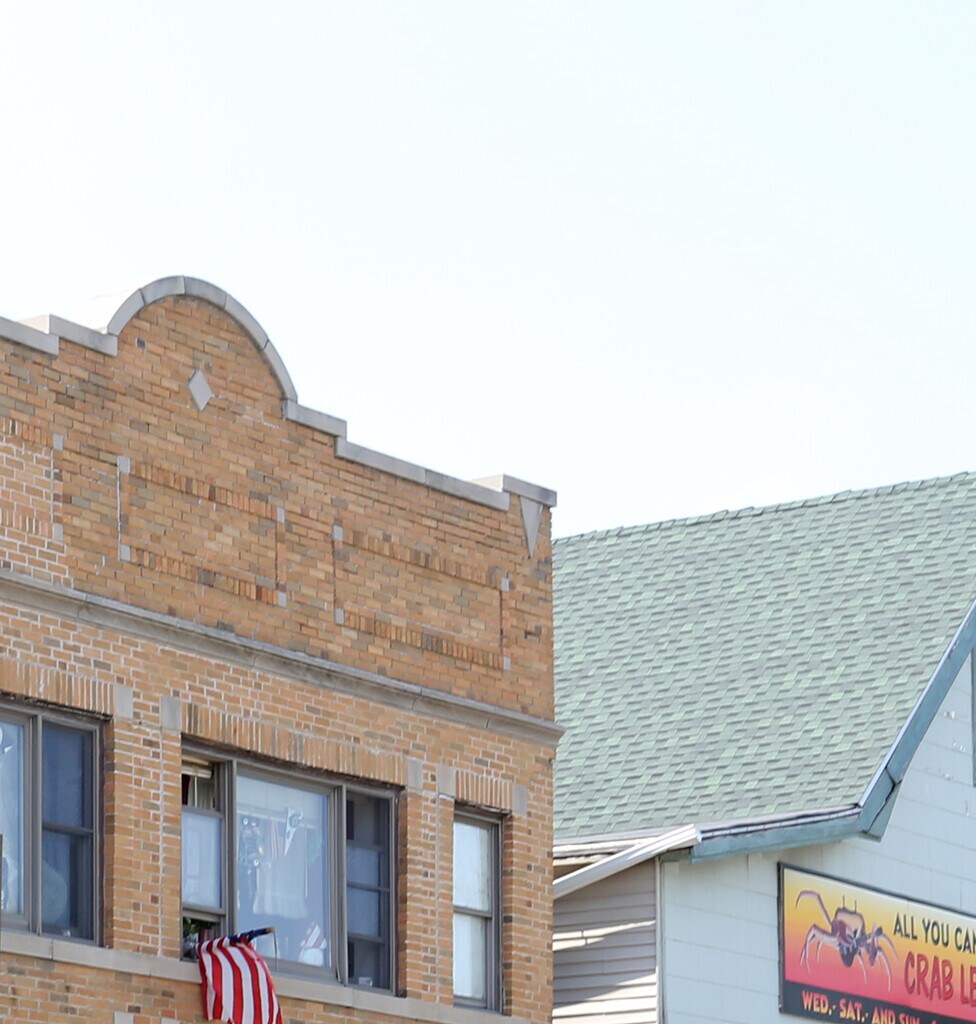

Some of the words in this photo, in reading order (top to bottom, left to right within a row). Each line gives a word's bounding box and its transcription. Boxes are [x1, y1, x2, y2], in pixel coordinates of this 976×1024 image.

[893, 912, 918, 940] ALL
[922, 918, 949, 948] YOU
[904, 951, 954, 1001] CRAB
